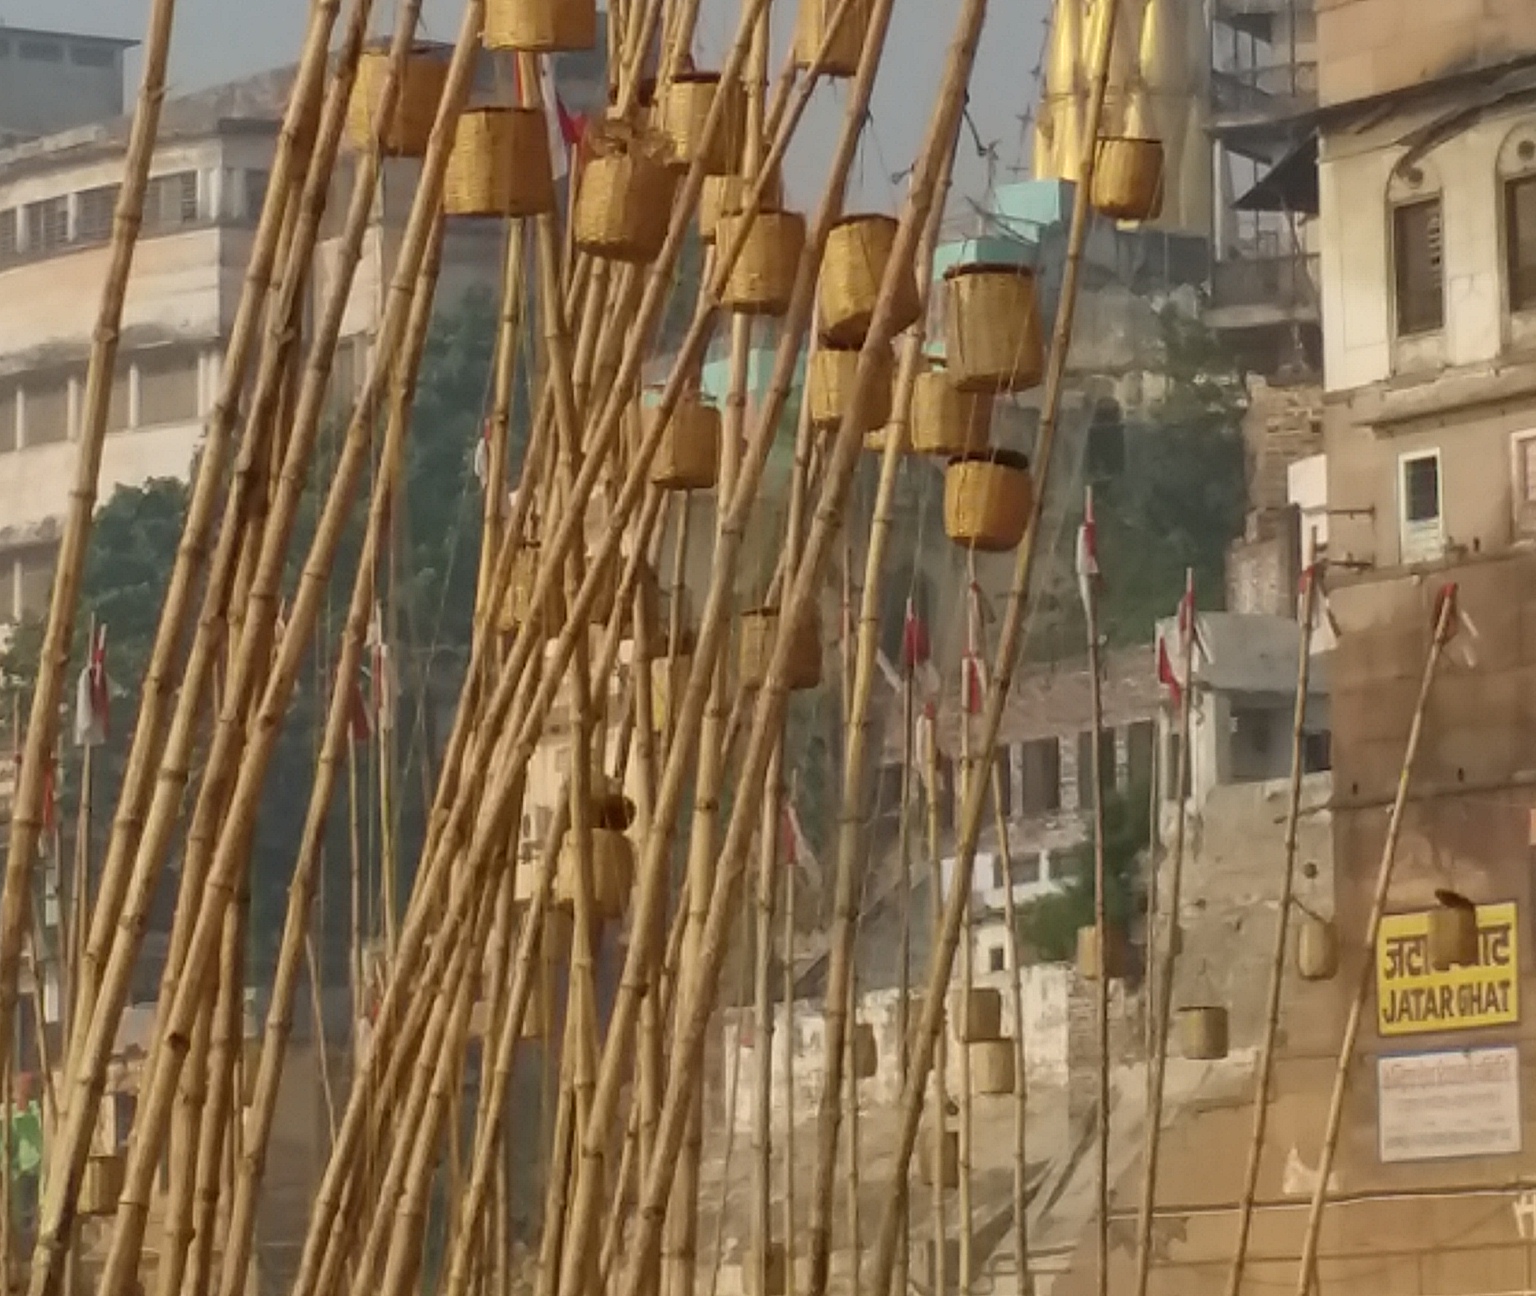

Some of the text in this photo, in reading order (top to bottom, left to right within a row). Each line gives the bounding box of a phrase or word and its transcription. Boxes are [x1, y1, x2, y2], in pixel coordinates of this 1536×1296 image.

[1384, 923, 1512, 980] जटा ाट
[1382, 980, 1510, 1024] JATAR GHAT
